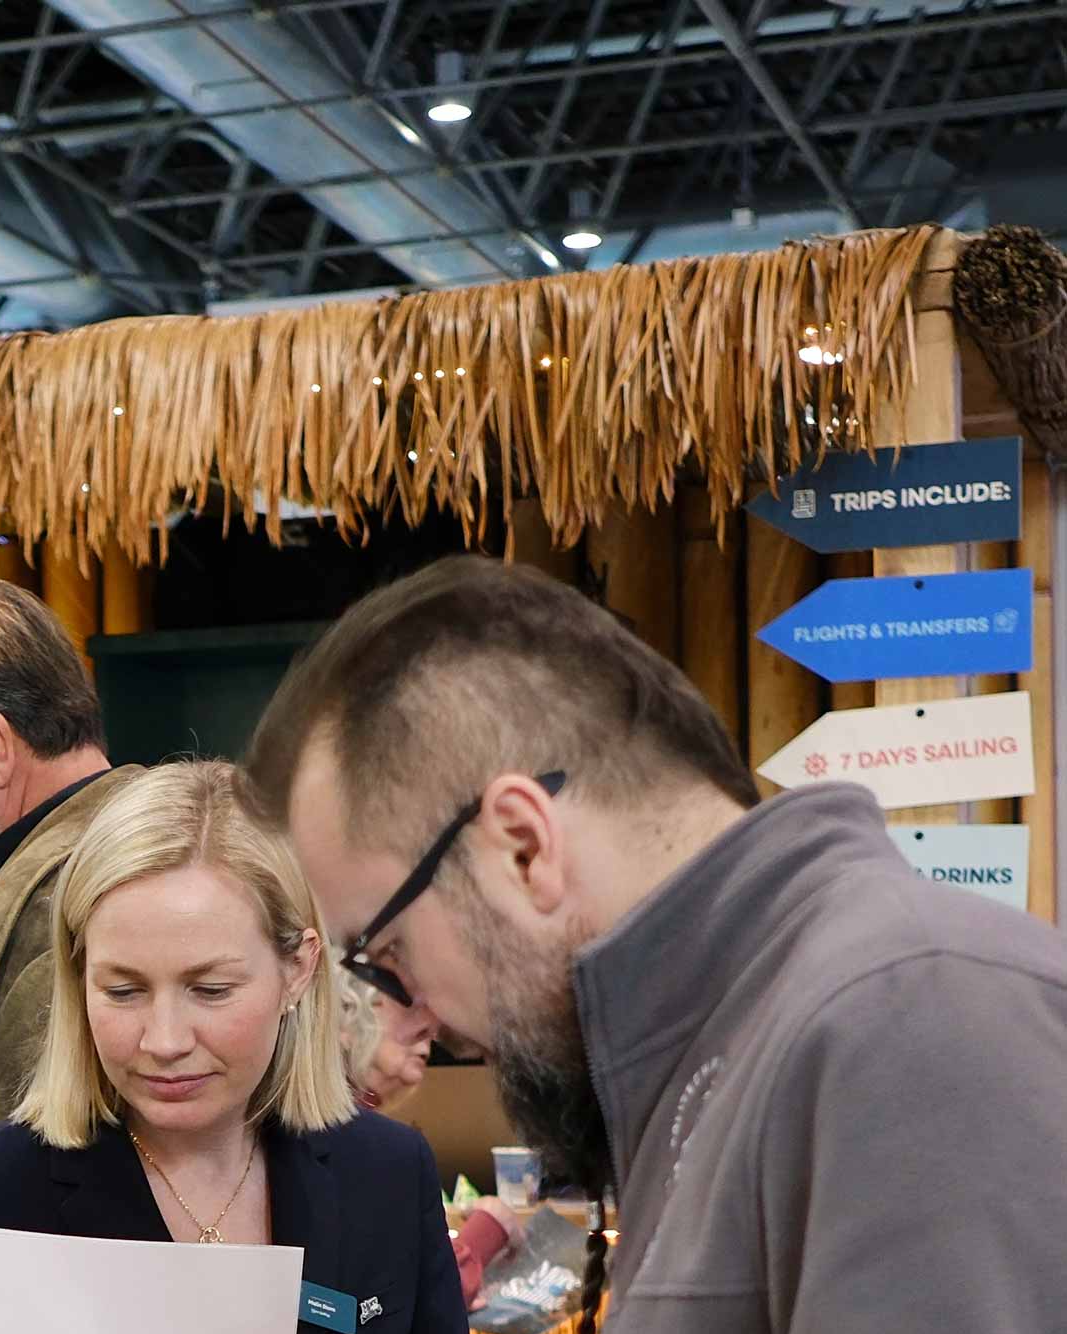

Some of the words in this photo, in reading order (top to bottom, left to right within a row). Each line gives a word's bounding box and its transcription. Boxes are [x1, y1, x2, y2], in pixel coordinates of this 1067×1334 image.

[830, 489, 896, 512] TRIPS
[901, 481, 1011, 507] INCLUDE:
[793, 623, 867, 643] FLIGHTS
[869, 623, 882, 638] &
[885, 617, 989, 638] TRANSFERS
[839, 754, 852, 770] 7
[858, 746, 918, 770] DAYS
[924, 736, 1019, 763] SAILING
[932, 866, 1014, 885] DRINKS
